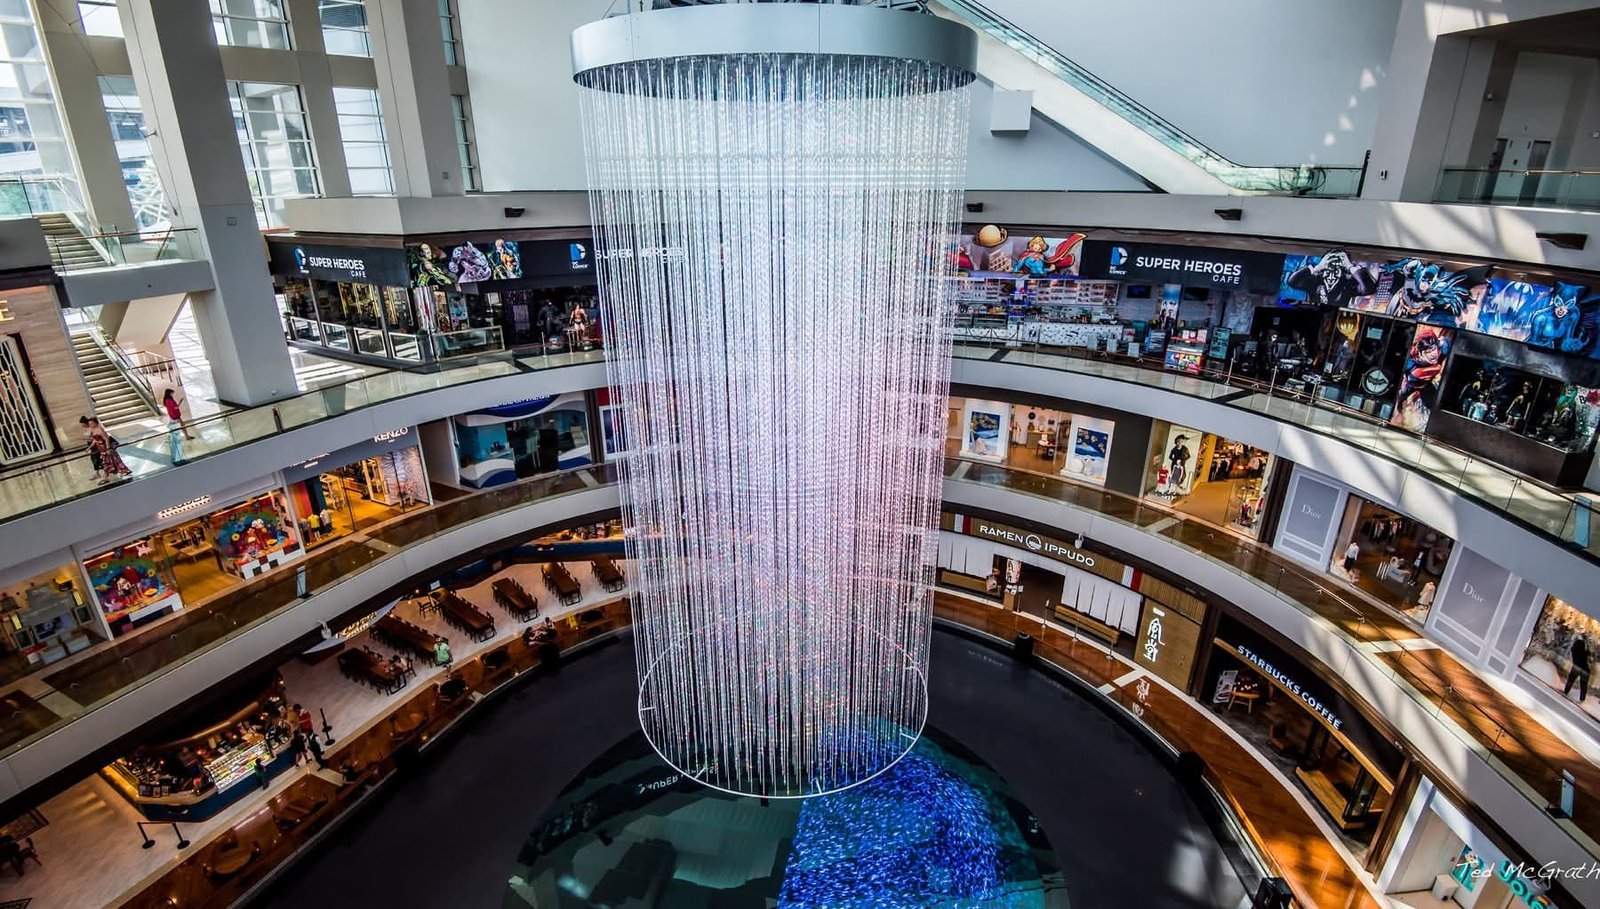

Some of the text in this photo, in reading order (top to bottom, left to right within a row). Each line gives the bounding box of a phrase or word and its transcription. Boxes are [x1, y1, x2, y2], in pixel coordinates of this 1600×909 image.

[309, 257, 365, 271] SUPER HEROES
[1136, 256, 1242, 276] SUPER HEROES
[350, 270, 367, 278] CAFE
[1212, 274, 1240, 284] CAFE
[374, 427, 408, 443] KENZO
[1302, 504, 1321, 519] Dior
[980, 525, 1095, 567] RAMEN IPPUDO
[1463, 582, 1484, 603] Dior
[1237, 645, 1301, 695] STARBUCKS
[1301, 692, 1342, 730] COFFEE
